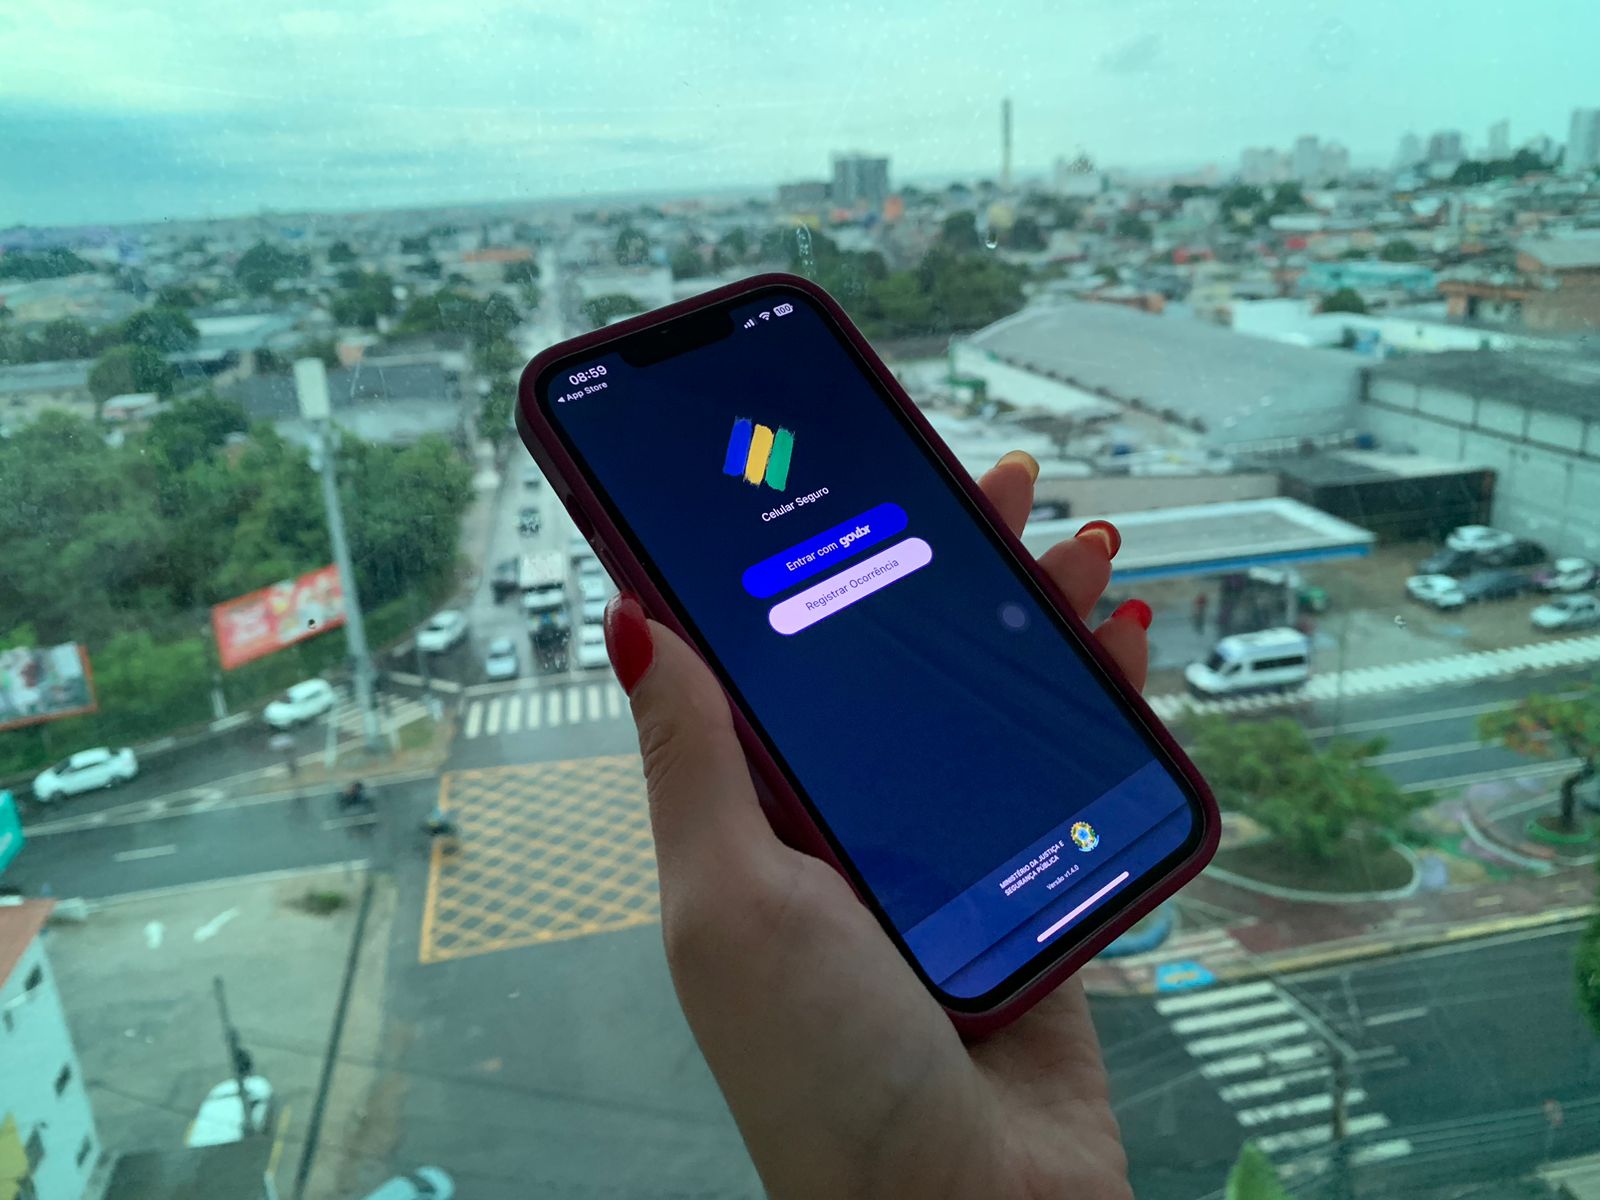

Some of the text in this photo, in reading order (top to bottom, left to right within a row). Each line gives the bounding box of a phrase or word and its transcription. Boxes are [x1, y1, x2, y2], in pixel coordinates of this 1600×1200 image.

[775, 304, 791, 315] 100
[566, 380, 608, 402] App Store
[568, 365, 608, 386] 08:59
[761, 486, 830, 522] Celular Seguro
[785, 552, 816, 572] Entrar
[817, 541, 839, 557] com
[805, 558, 900, 611] Registrar Ocorrência
[999, 865, 1030, 889] MINISTÉRIO
[1029, 859, 1039, 868] DA
[1038, 844, 1060, 862] JUSTIÇA
[1004, 855, 1059, 896] SEGURANÇA PÚBLICA
[1046, 876, 1064, 890] Versão
